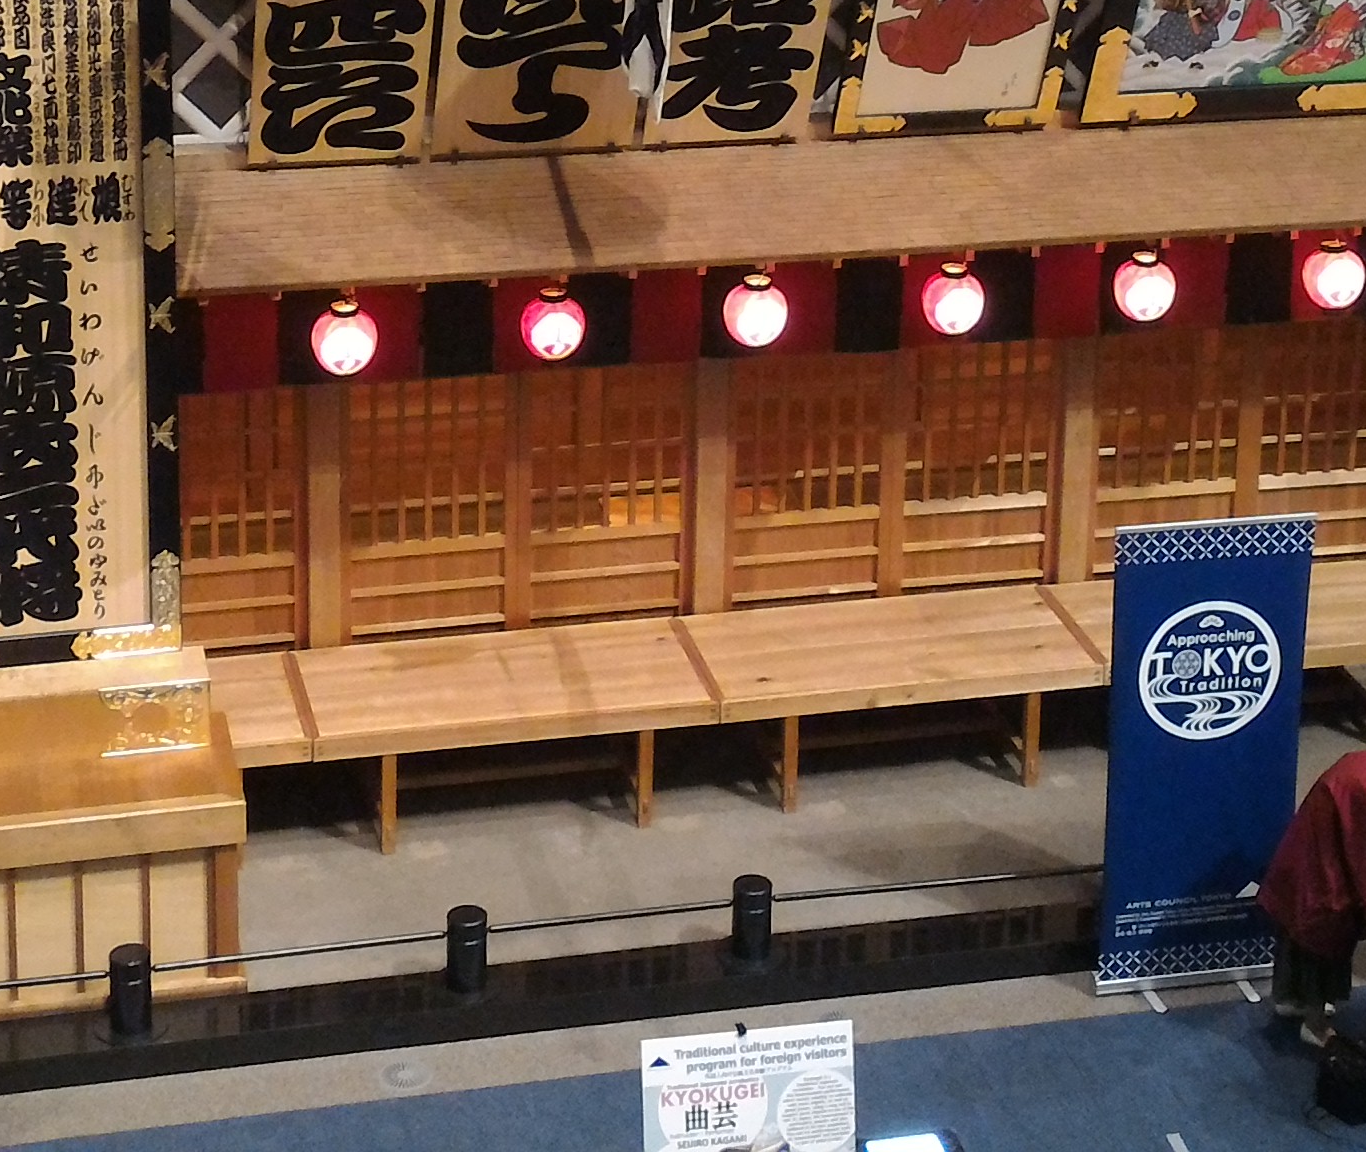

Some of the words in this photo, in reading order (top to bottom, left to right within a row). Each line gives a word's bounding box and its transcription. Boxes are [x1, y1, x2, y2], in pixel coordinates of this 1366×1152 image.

[1166, 627, 1255, 649] Approaching
[1150, 643, 1271, 680] TOKYO
[1179, 673, 1263, 694] Tradition
[674, 1043, 736, 1061] Traditional
[739, 1039, 781, 1054] culture
[784, 1033, 847, 1052] experience
[686, 1057, 737, 1075] program
[740, 1054, 757, 1068] for
[760, 1050, 802, 1069] foreign
[804, 1046, 847, 1062] visitors
[661, 1082, 766, 1108] KYOKUGEI
[685, 1100, 738, 1132] 曲芸
